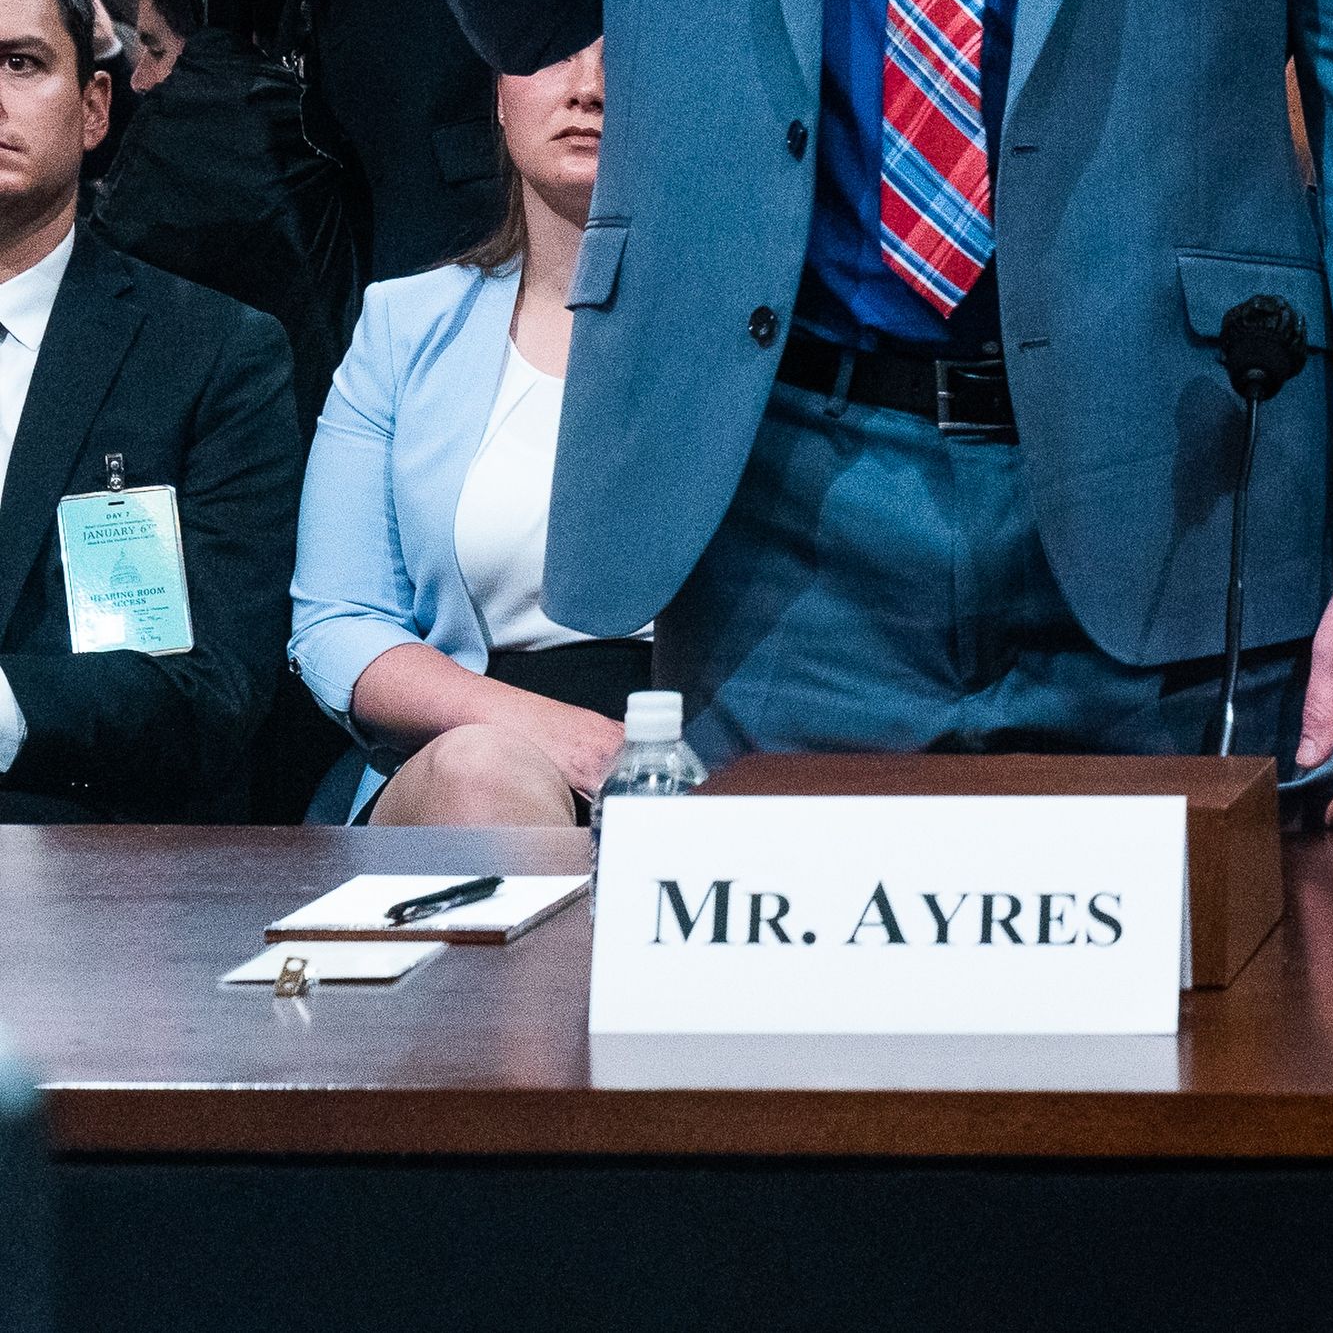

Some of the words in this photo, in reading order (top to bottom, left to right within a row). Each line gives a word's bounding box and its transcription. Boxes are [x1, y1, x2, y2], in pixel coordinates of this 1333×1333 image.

[83, 525, 136, 541] JANUARY
[137, 586, 166, 597] ROOM
[844, 880, 1123, 946] AYRES
